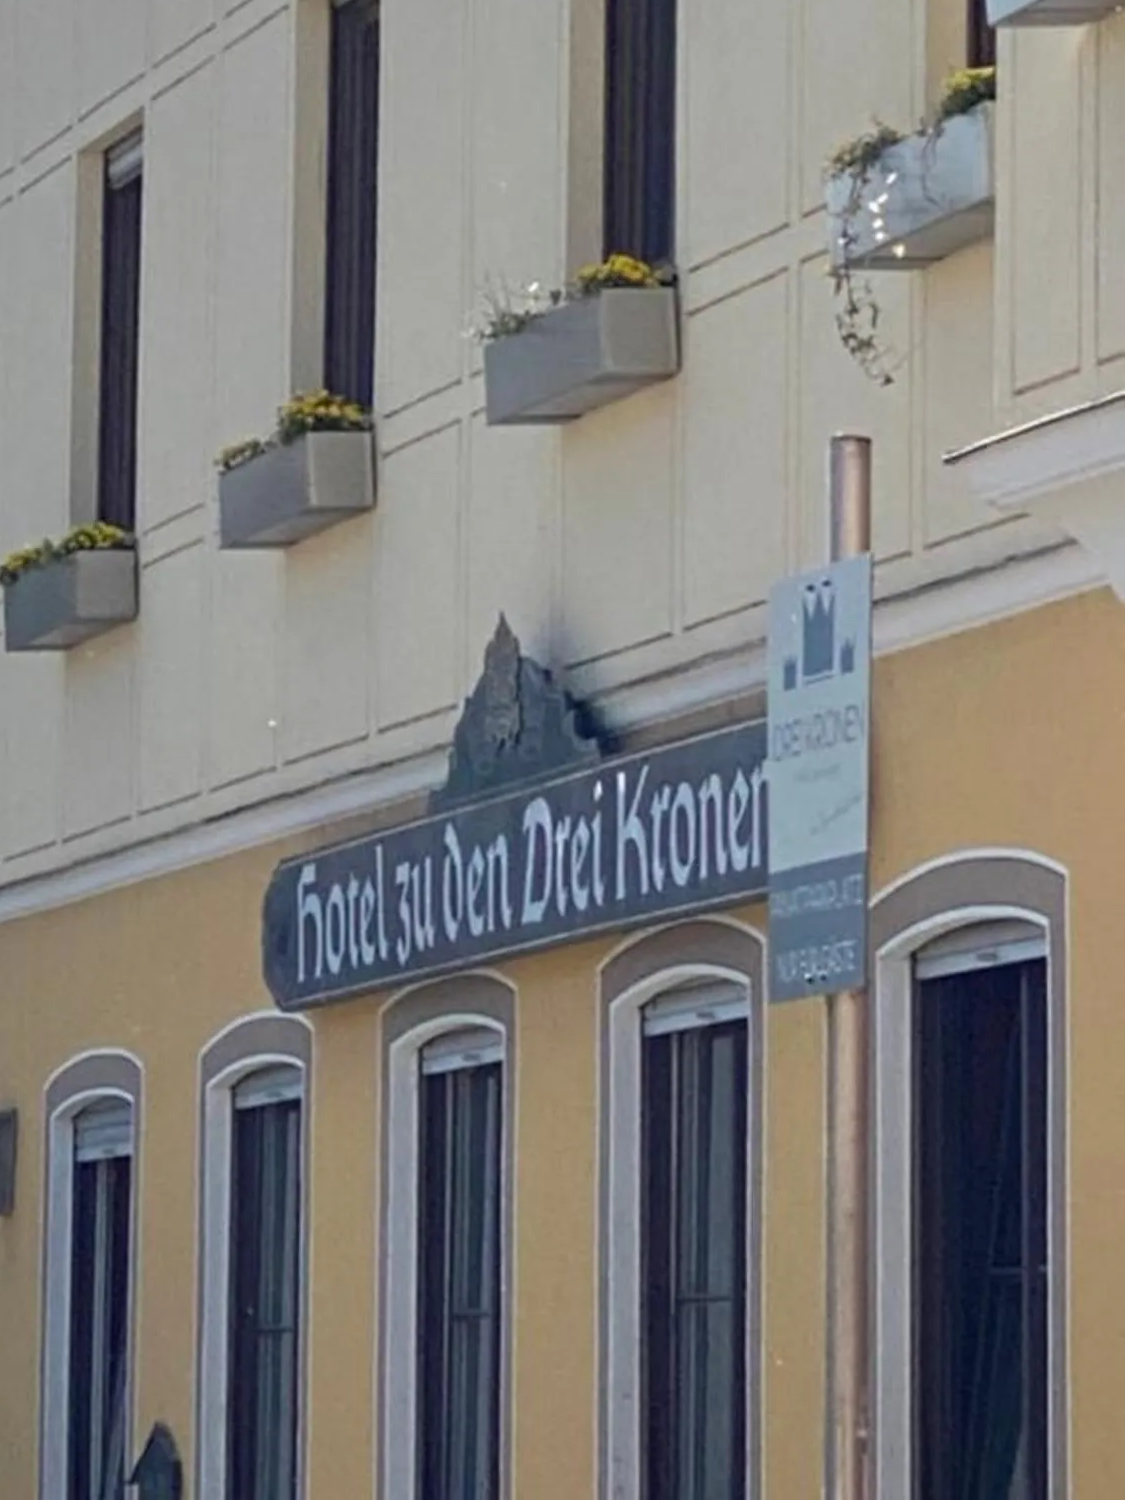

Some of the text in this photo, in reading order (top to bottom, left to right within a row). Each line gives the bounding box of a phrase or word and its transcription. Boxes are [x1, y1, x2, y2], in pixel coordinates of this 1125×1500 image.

[297, 843, 388, 983] Hotel
[395, 855, 435, 967] zu
[443, 821, 512, 943] den
[521, 779, 605, 926] Drei
